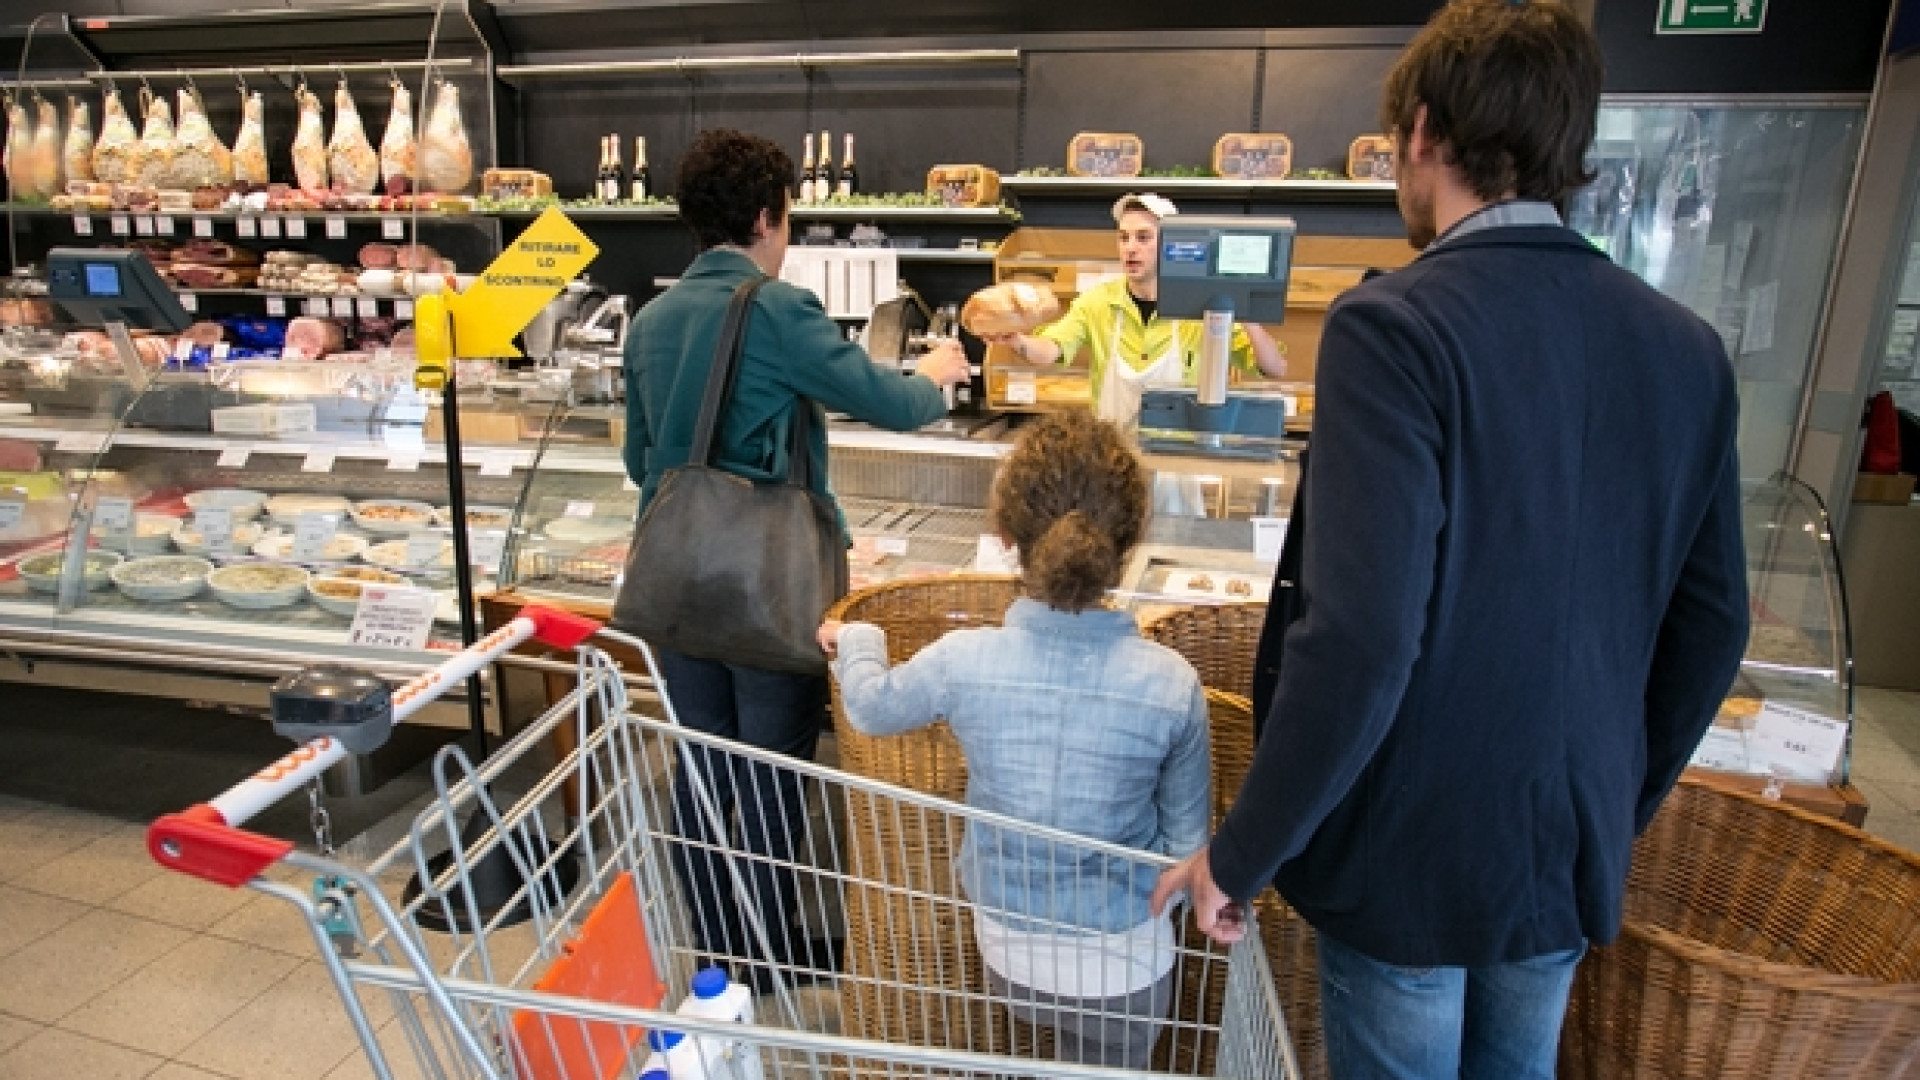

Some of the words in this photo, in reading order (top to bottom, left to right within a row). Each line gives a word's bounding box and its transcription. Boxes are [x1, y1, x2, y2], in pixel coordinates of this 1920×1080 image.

[519, 241, 580, 255] RITIRARE
[536, 257, 555, 268] LO
[484, 274, 565, 287] SCONTRINO
